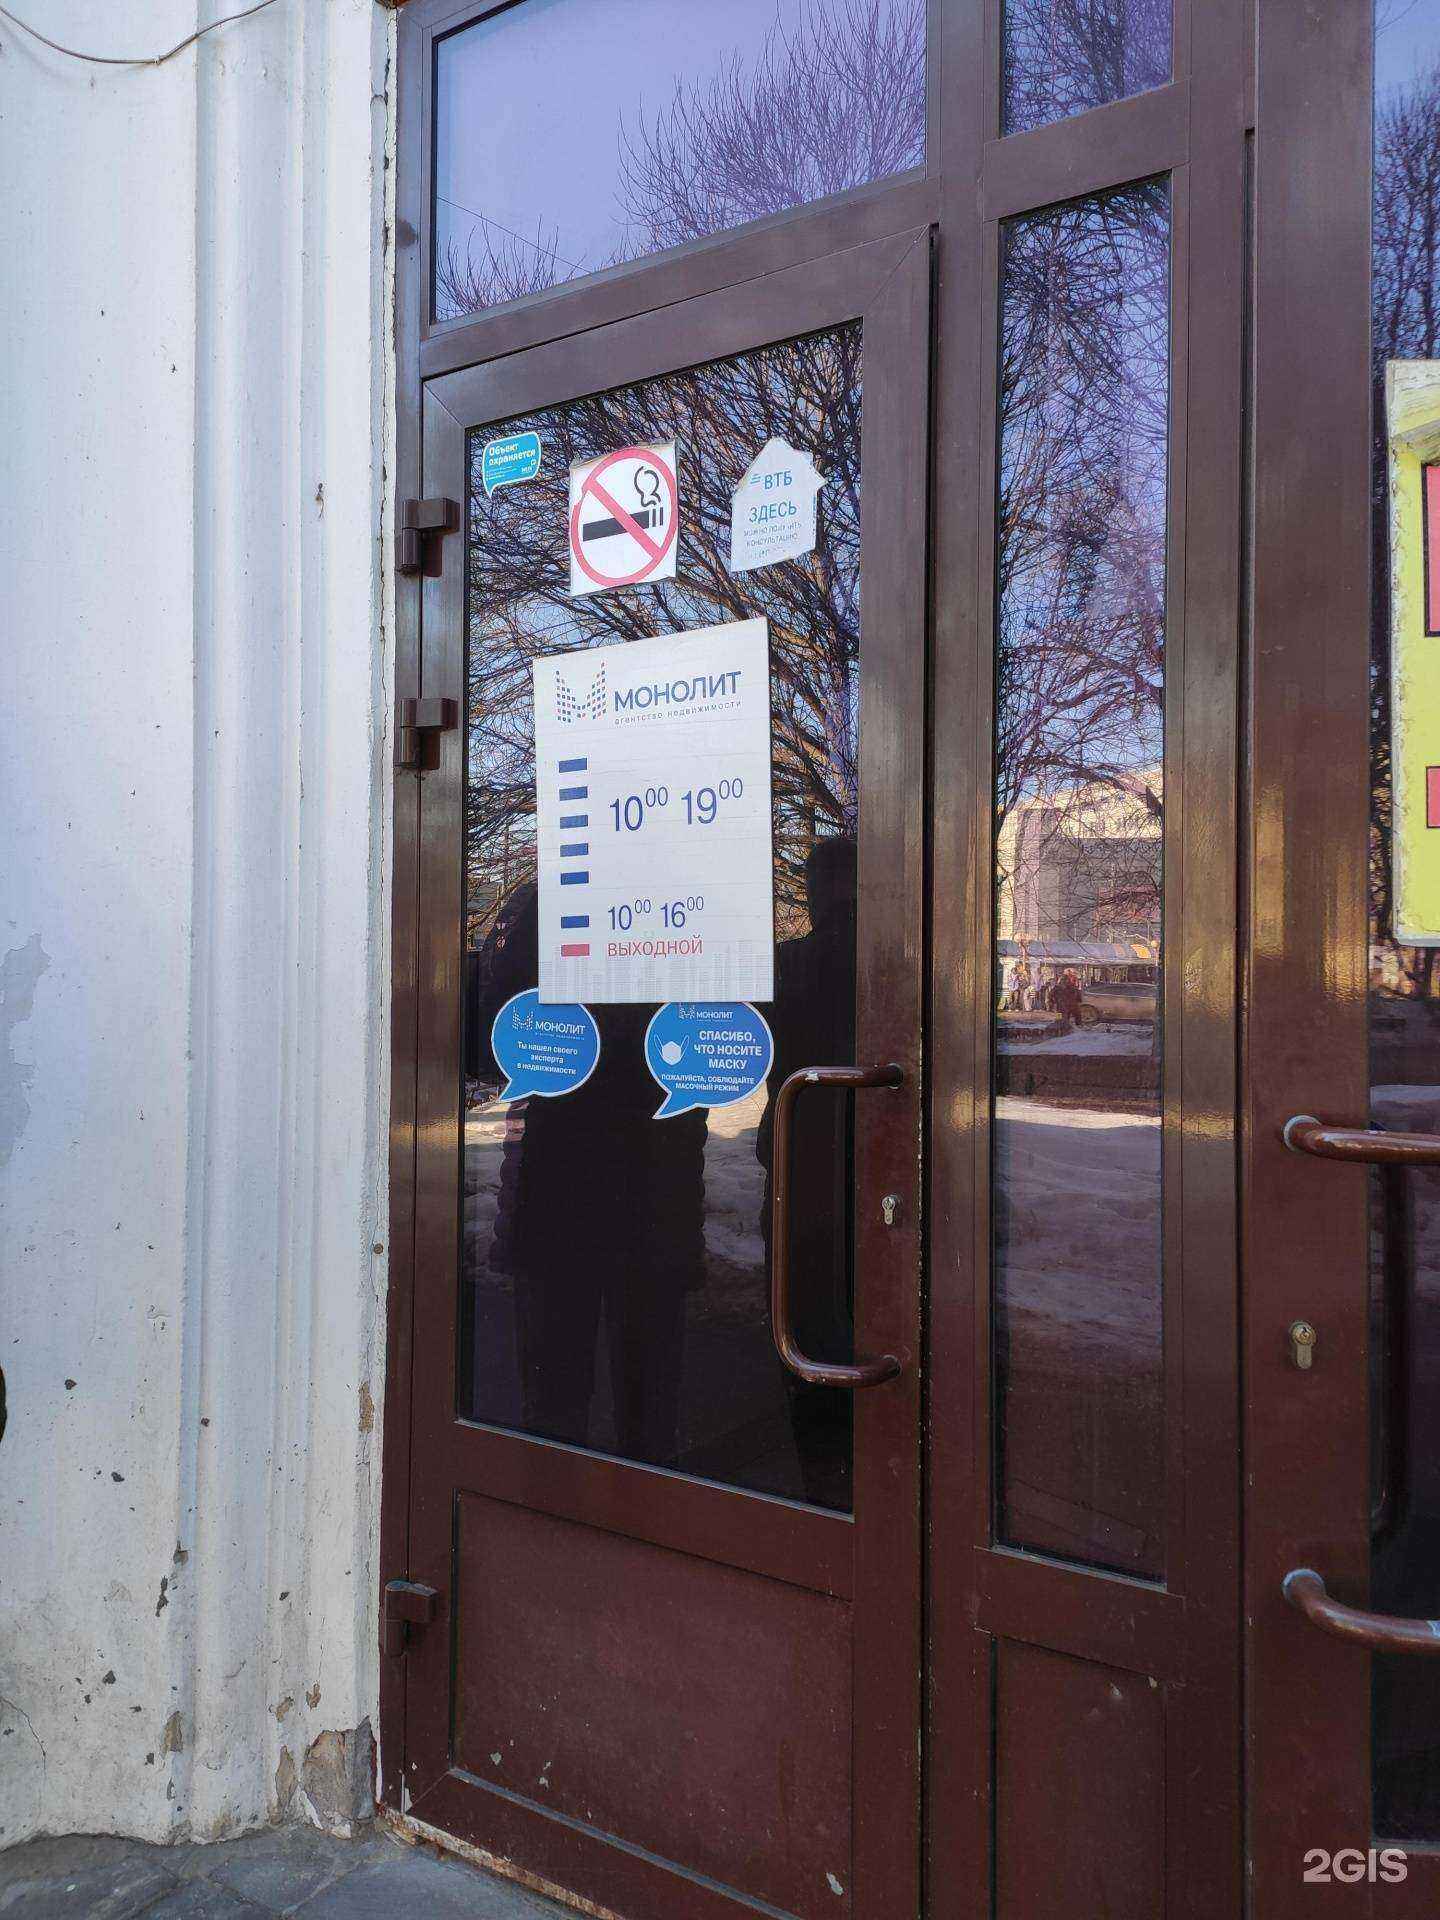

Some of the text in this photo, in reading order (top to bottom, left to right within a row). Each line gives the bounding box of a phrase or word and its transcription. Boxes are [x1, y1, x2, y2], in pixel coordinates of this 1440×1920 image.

[490, 444, 519, 456] Объект
[489, 449, 536, 466] охраняется
[764, 471, 792, 489] ВТБ
[749, 501, 797, 524] ЗДЕСЬ
[614, 671, 742, 712] МОНОЛИТ
[614, 701, 742, 725] агентство недвижимости
[607, 935, 703, 958] ВЫХОДНОЙ
[696, 1011, 733, 1020] МОНОЛИТ
[535, 1021, 586, 1035] МОНОЛИТ
[699, 1030, 756, 1043] СПАСИБО,
[517, 1041, 578, 1055] Ты нашел своего
[694, 1044, 762, 1056] ЧТО НОСИТЕ
[522, 1064, 576, 1075] недвижимости
[708, 1059, 747, 1070] МАСКУ
[661, 1074, 755, 1085] ПОЖАЛУЙСТА, СОБЛЮДАЙТЕ
[676, 1083, 740, 1092] МАСОЧНЫЙ РЕЖИМ
